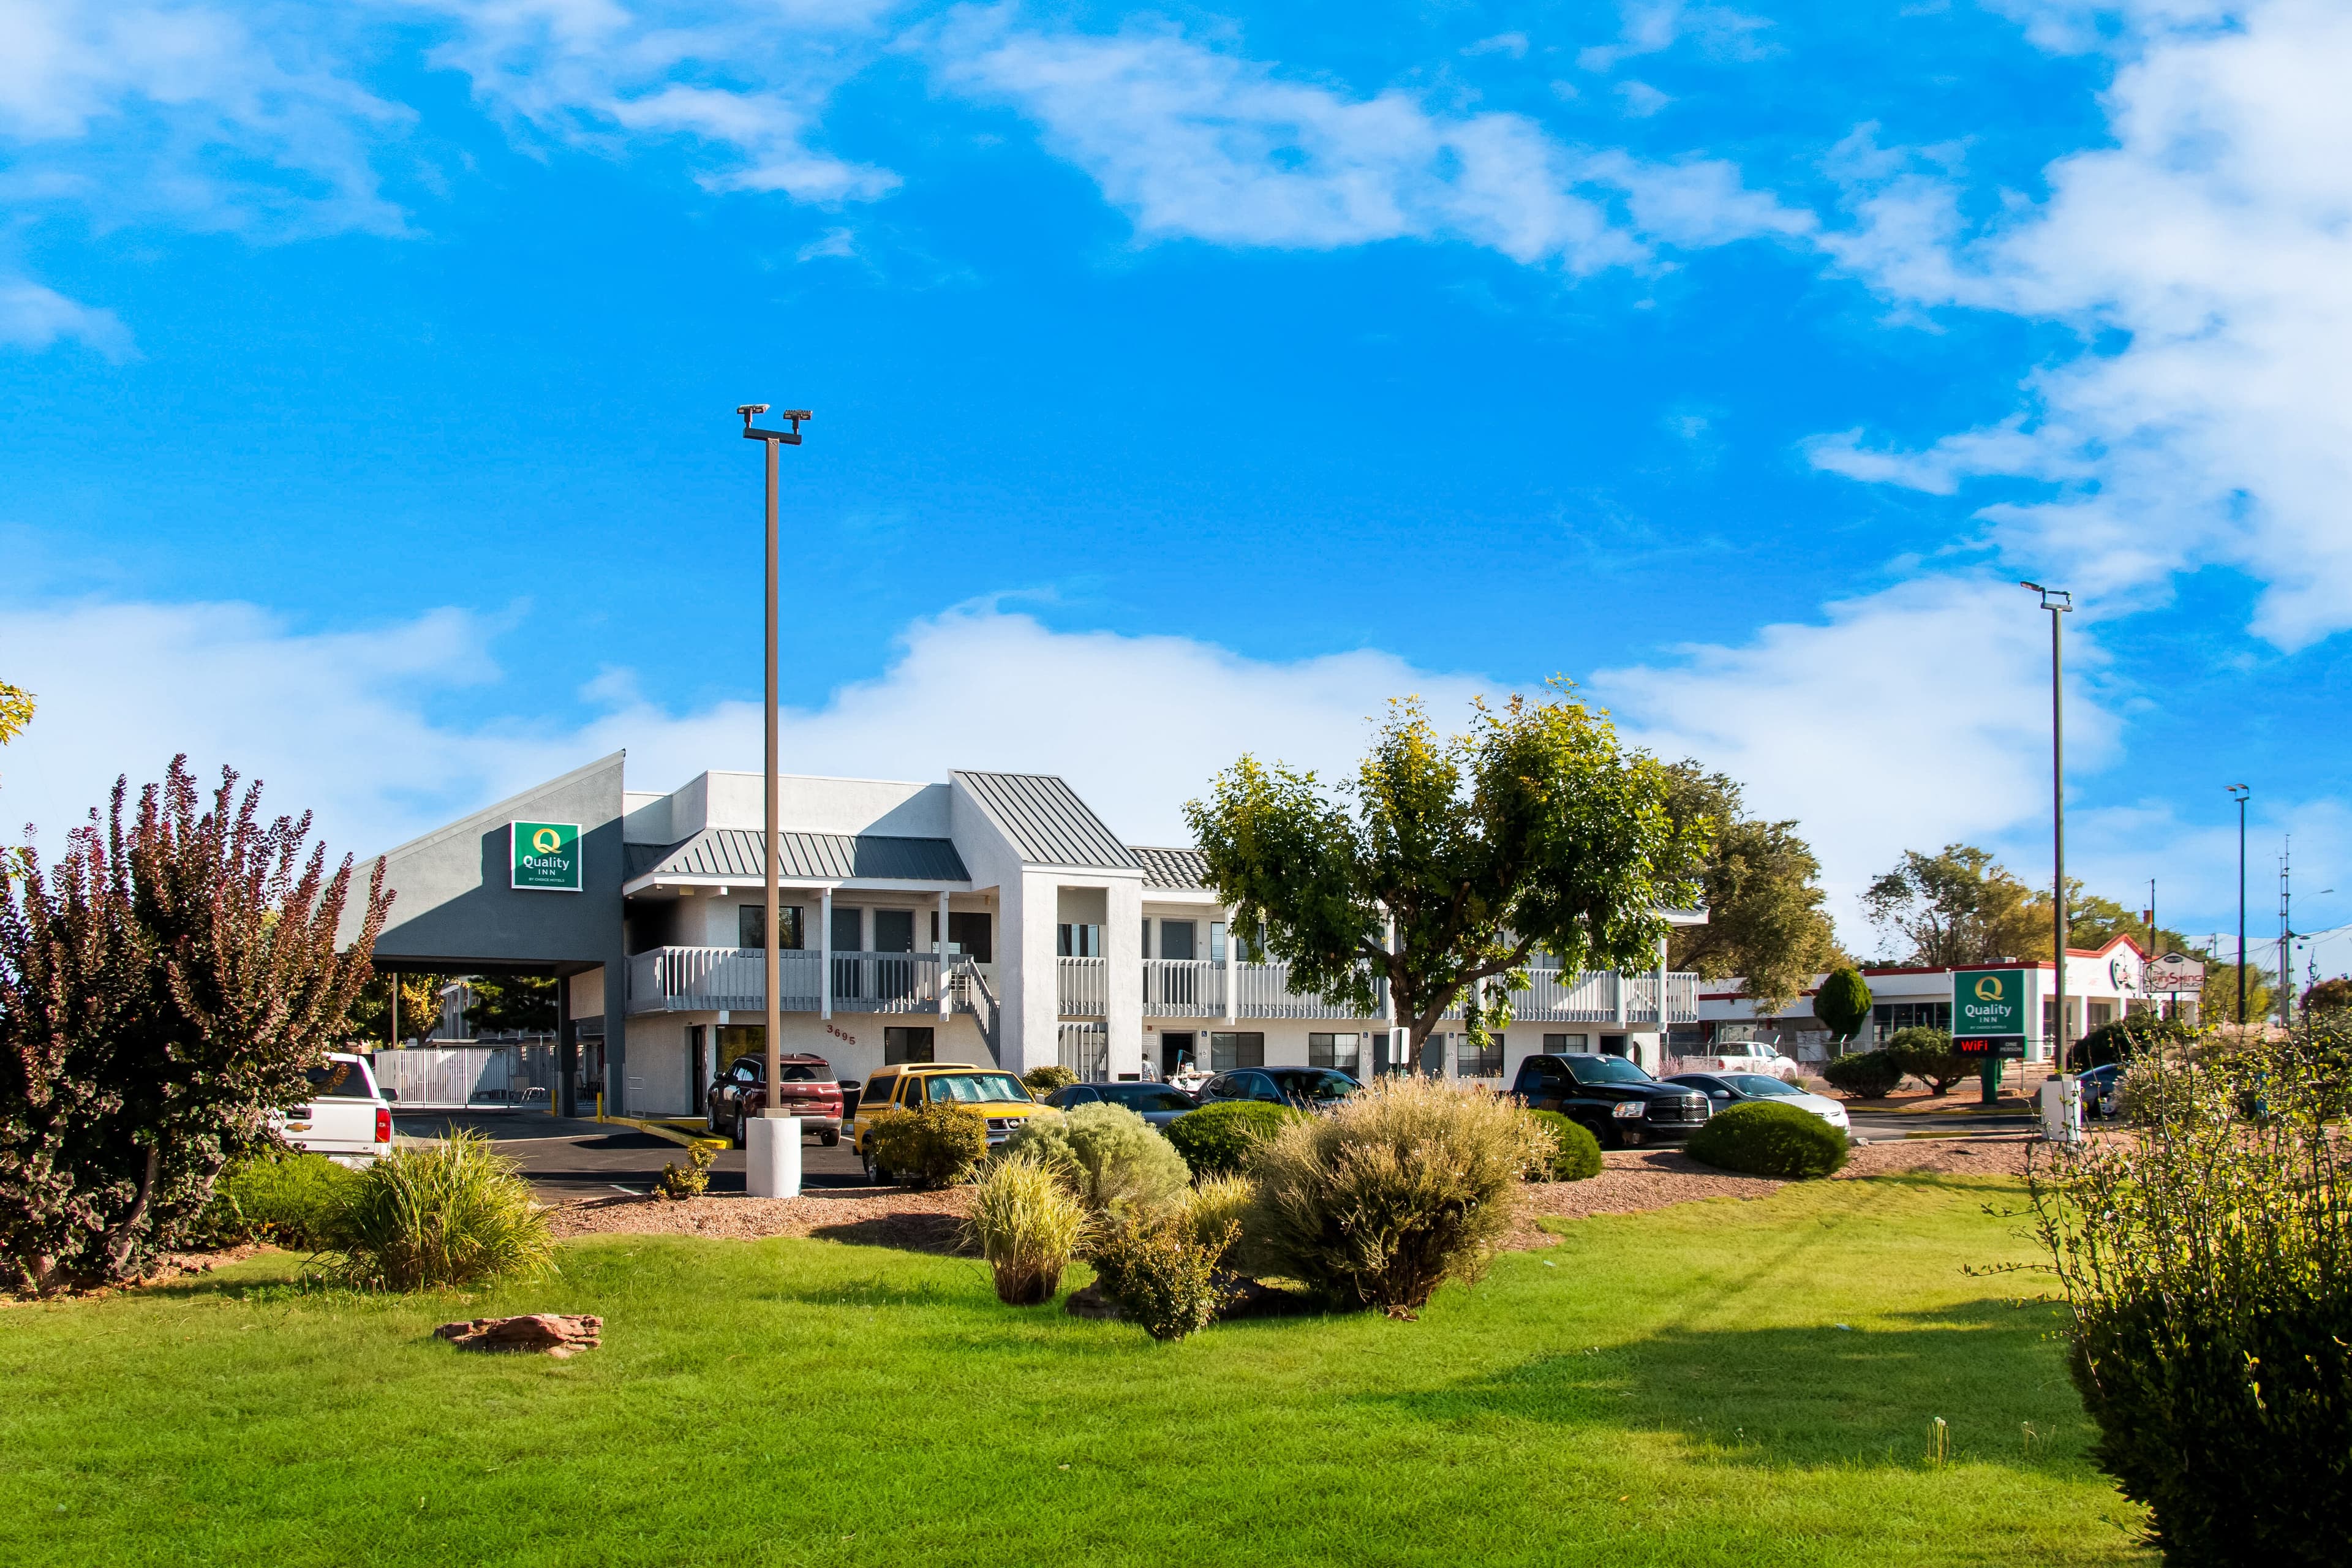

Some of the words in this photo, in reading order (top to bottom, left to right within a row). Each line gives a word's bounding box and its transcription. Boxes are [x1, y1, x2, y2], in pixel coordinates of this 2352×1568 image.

[532, 827, 563, 854] Q
[523, 855, 570, 870] Quality
[1975, 976, 2005, 1001] Q
[1965, 1004, 2011, 1017] Quality
[827, 1025, 856, 1045] 3695
[1961, 1041, 1988, 1052] WiFi
